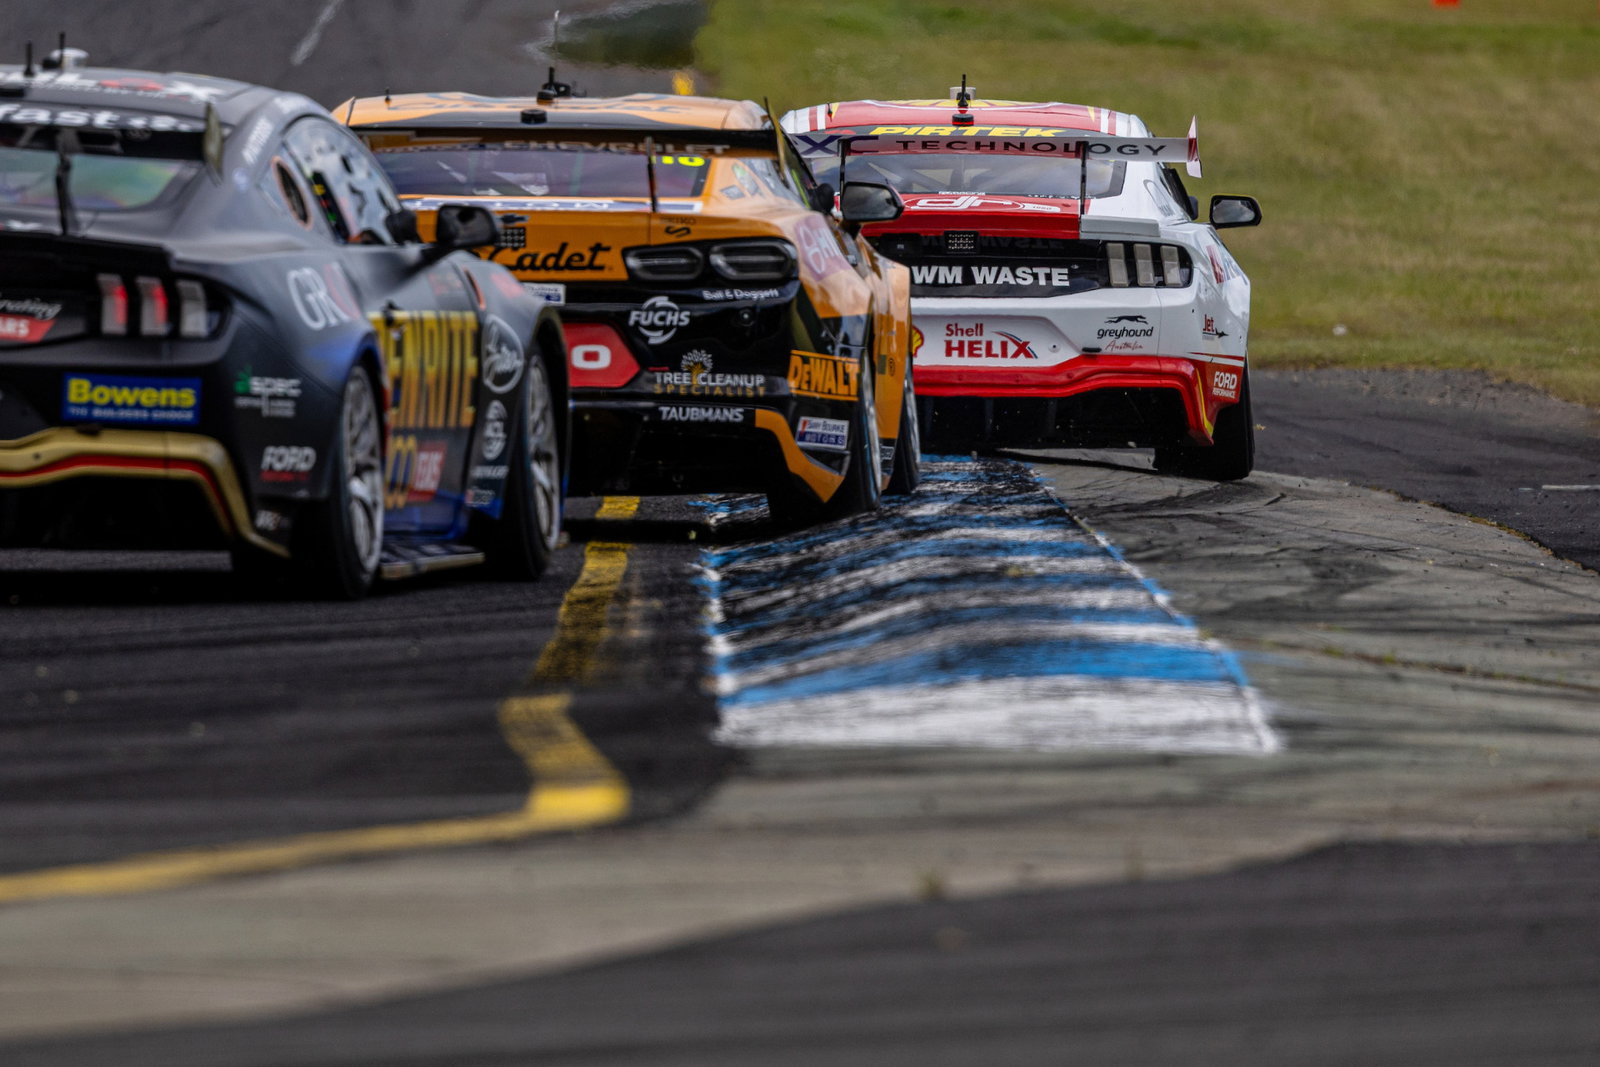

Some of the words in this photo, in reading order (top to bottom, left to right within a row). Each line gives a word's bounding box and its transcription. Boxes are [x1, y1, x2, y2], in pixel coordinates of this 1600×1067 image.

[868, 126, 1068, 137] PIRTEK
[896, 140, 1168, 156] TECHNOLOGY
[911, 266, 963, 284] WM
[971, 266, 1070, 287] WASTE
[628, 310, 691, 326] FUCHS
[1202, 313, 1215, 333] Jet
[945, 322, 984, 337] Shell
[1097, 326, 1154, 340] greyhound
[943, 338, 1035, 359] HELIX
[655, 372, 692, 384] TREE
[697, 372, 766, 387] CLEANUP
[1213, 370, 1238, 390] FORD
[67, 377, 197, 408] Bowens
[654, 383, 767, 398] SPECIALIST
[658, 406, 745, 423] TAUBMANS
[260, 445, 317, 472] FORD
